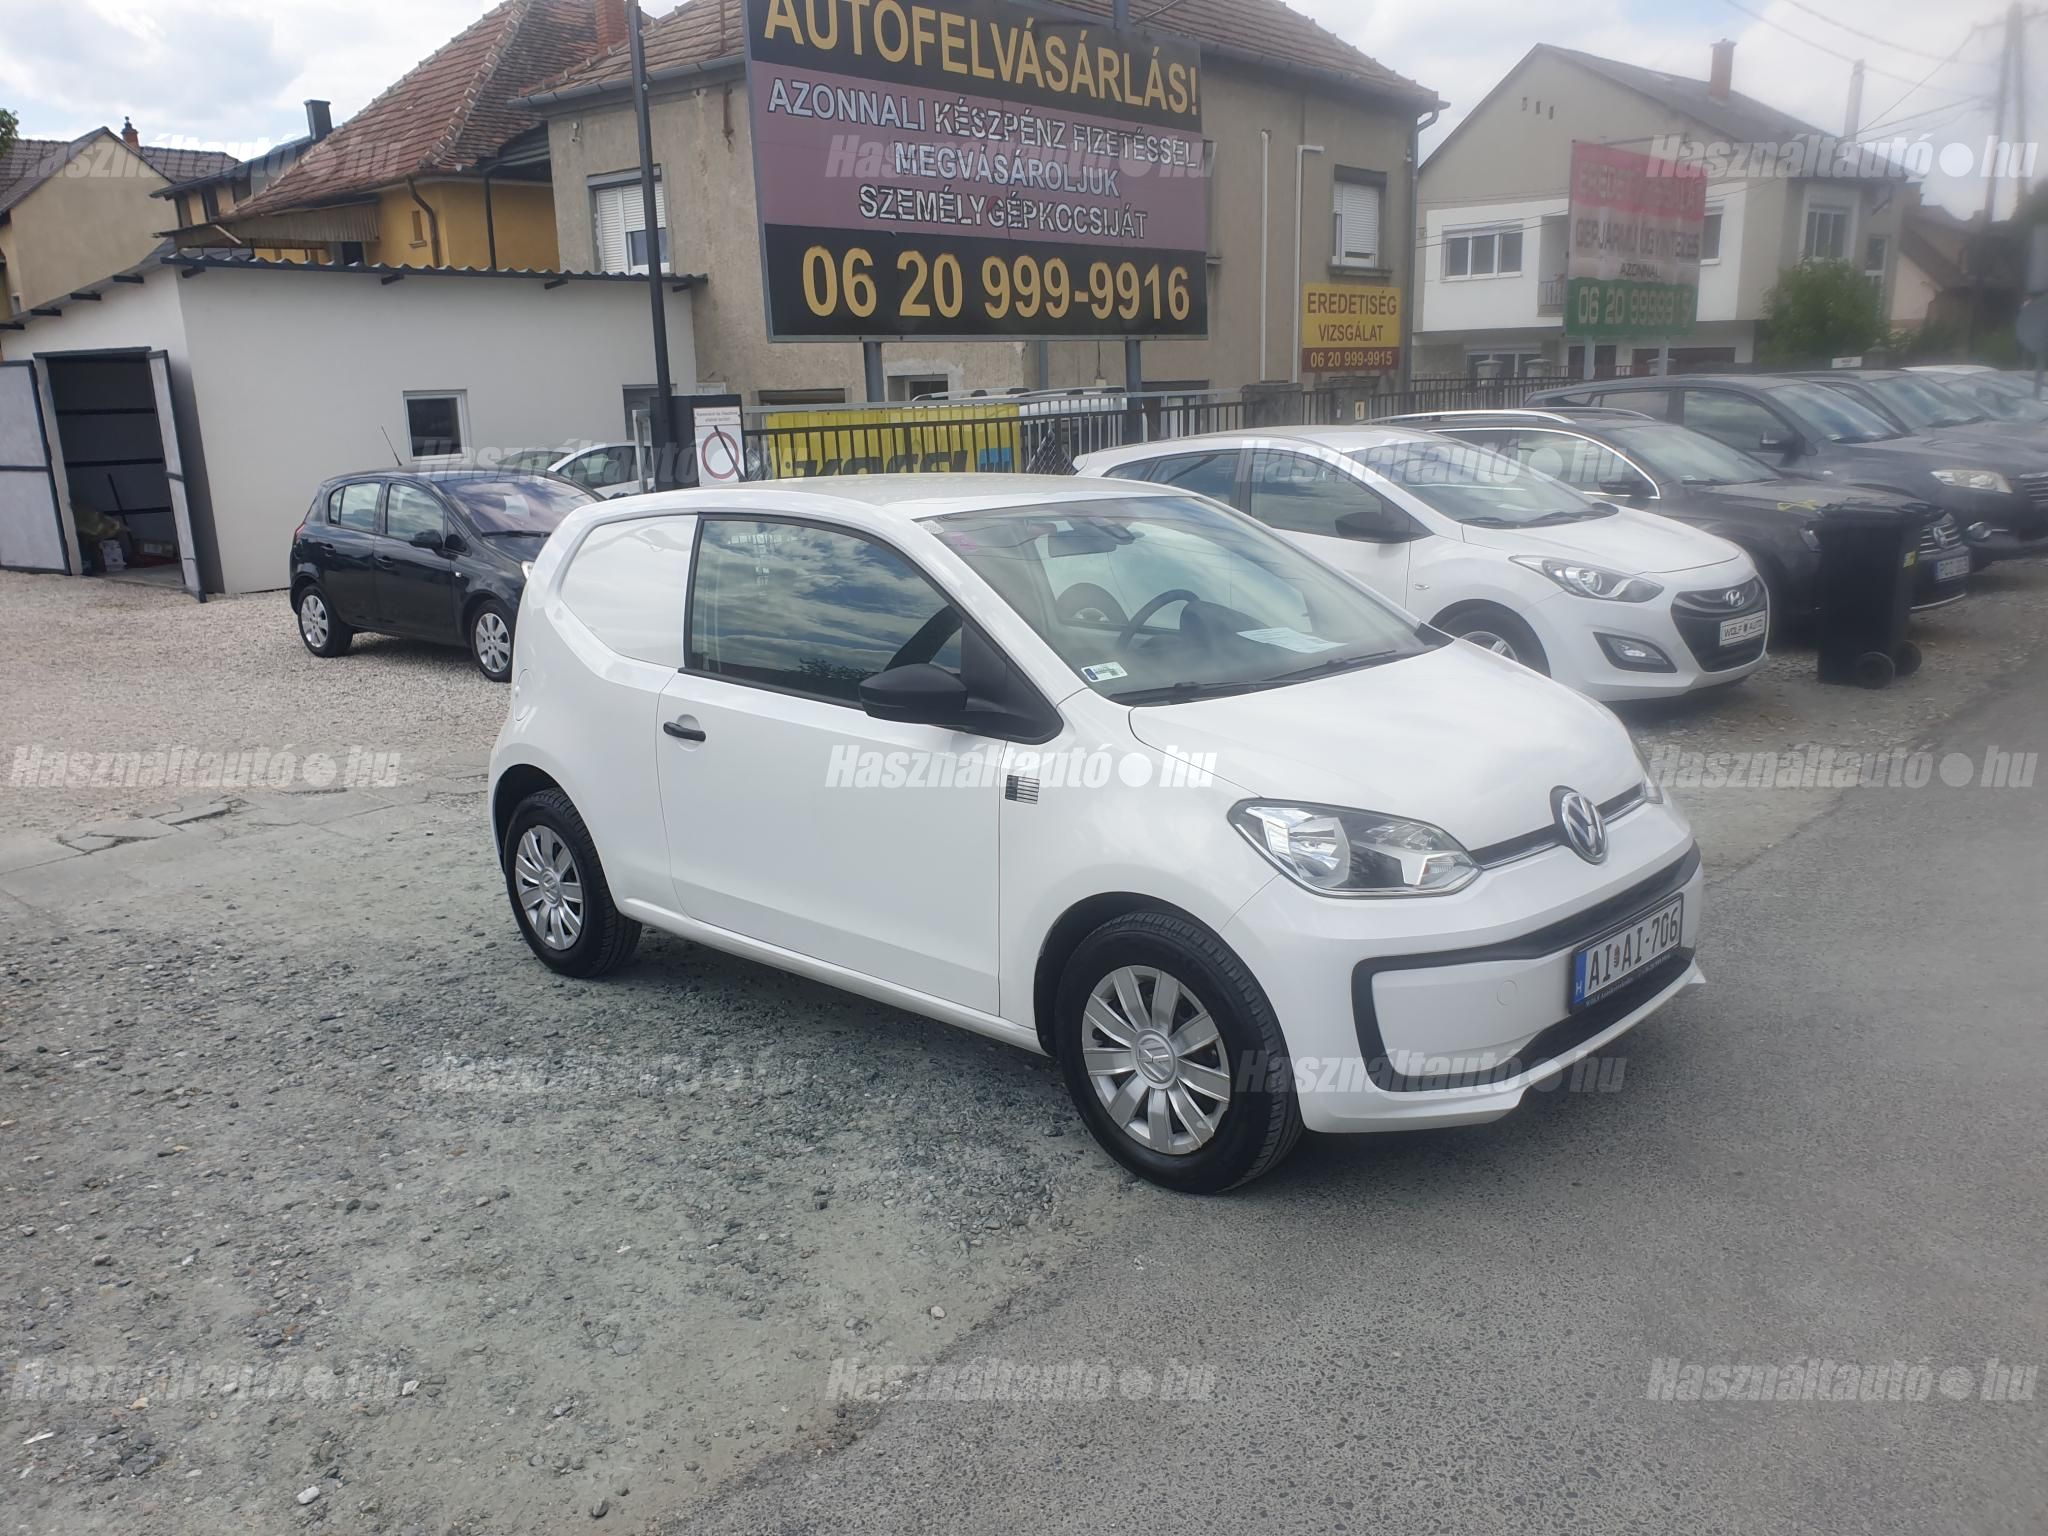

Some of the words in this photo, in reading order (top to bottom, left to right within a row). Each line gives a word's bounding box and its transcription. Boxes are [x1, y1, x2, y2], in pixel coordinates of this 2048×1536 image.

[768, 78, 926, 131] AZONNALI
[934, 98, 1067, 150] KÉSZPÉNZ
[1073, 122, 1199, 169] FIZETÉSSEL
[894, 141, 1121, 198] MEGVÁSÁROLJUK
[802, 245, 877, 318] 06
[896, 250, 963, 319] 20
[982, 255, 1190, 321] 999-9916
[1307, 290, 1397, 316] EREDETISÉG
[1310, 352, 1325, 368] 06
[1327, 352, 1341, 368] 20
[1344, 351, 1393, 367] 999-9915
[1318, 321, 1384, 342] VIZSGÁLAT
[1588, 944, 1612, 991] AI
[1620, 906, 1679, 972] AI-706
